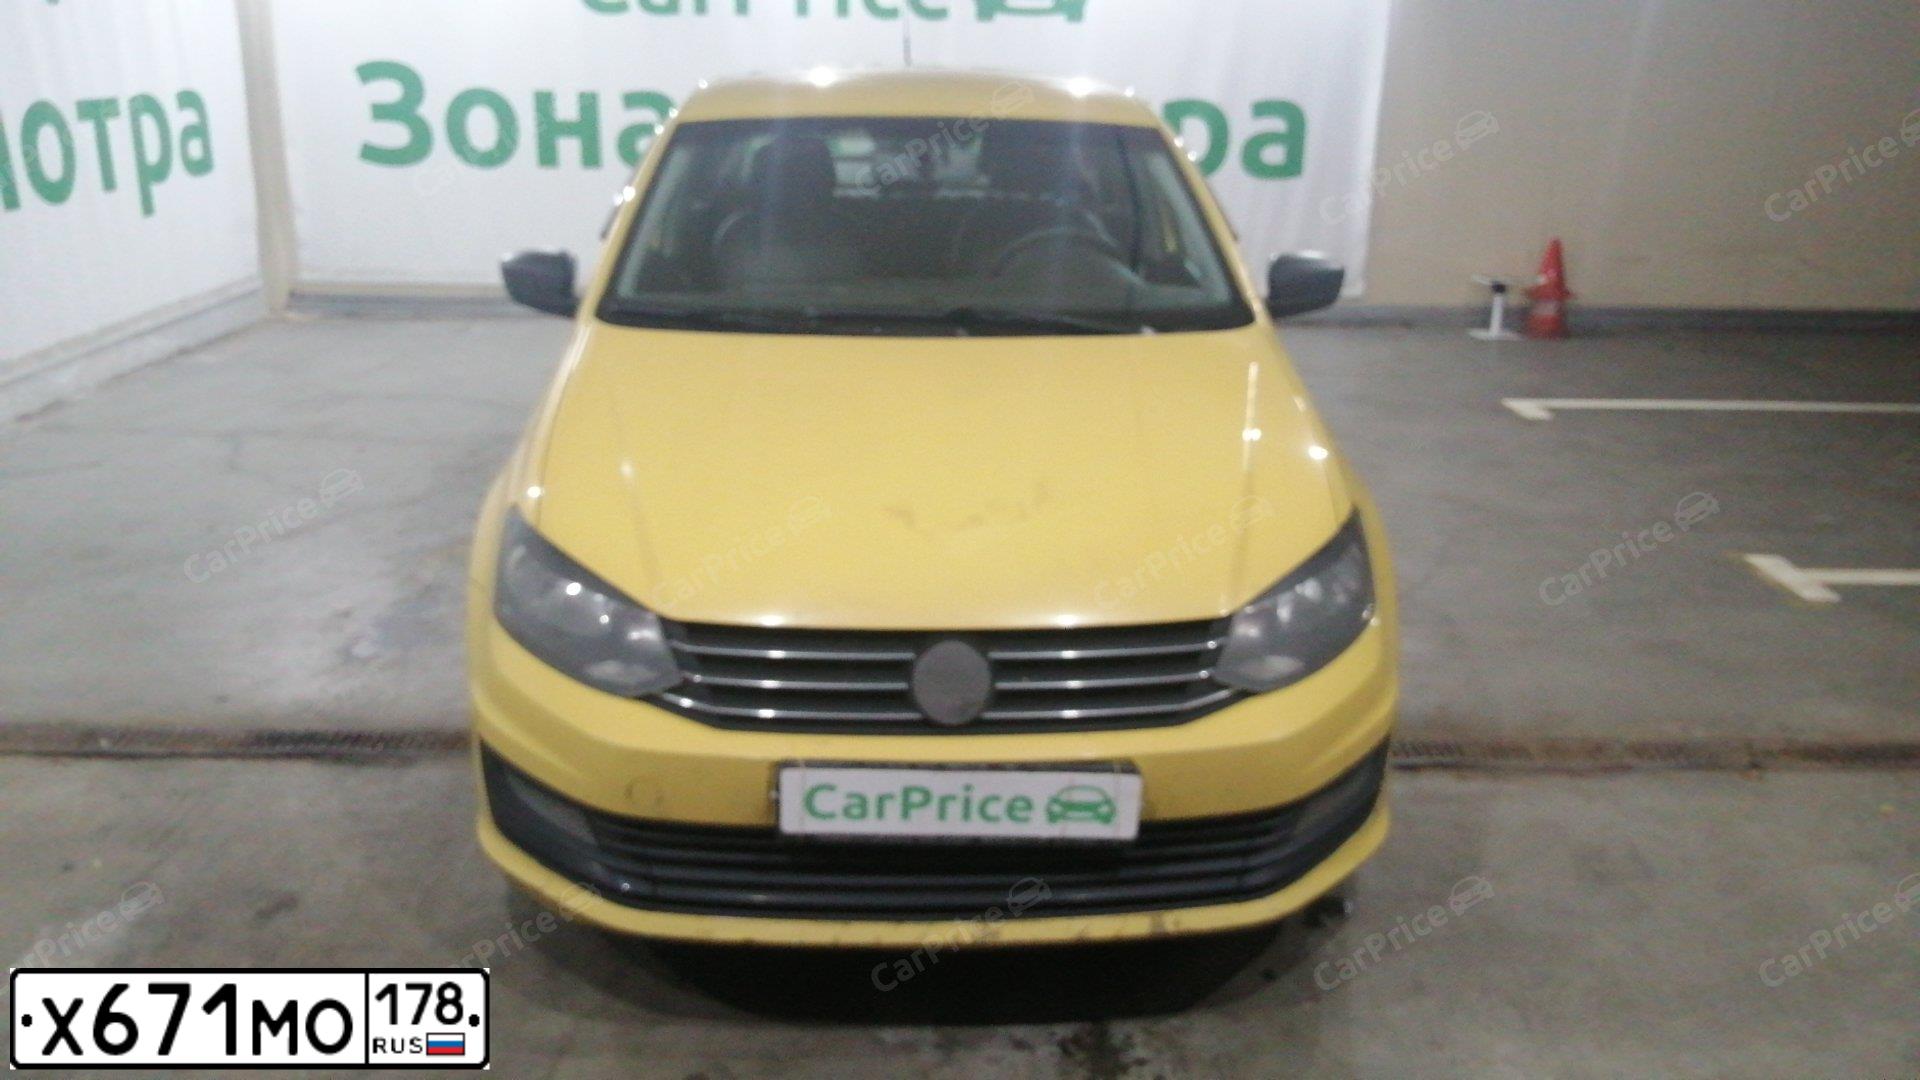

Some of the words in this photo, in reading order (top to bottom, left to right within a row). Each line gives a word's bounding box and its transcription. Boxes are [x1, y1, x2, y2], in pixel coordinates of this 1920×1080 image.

[0, 86, 215, 218] отра
[354, 59, 674, 171] Зона
[803, 784, 1035, 823] CarPrice
